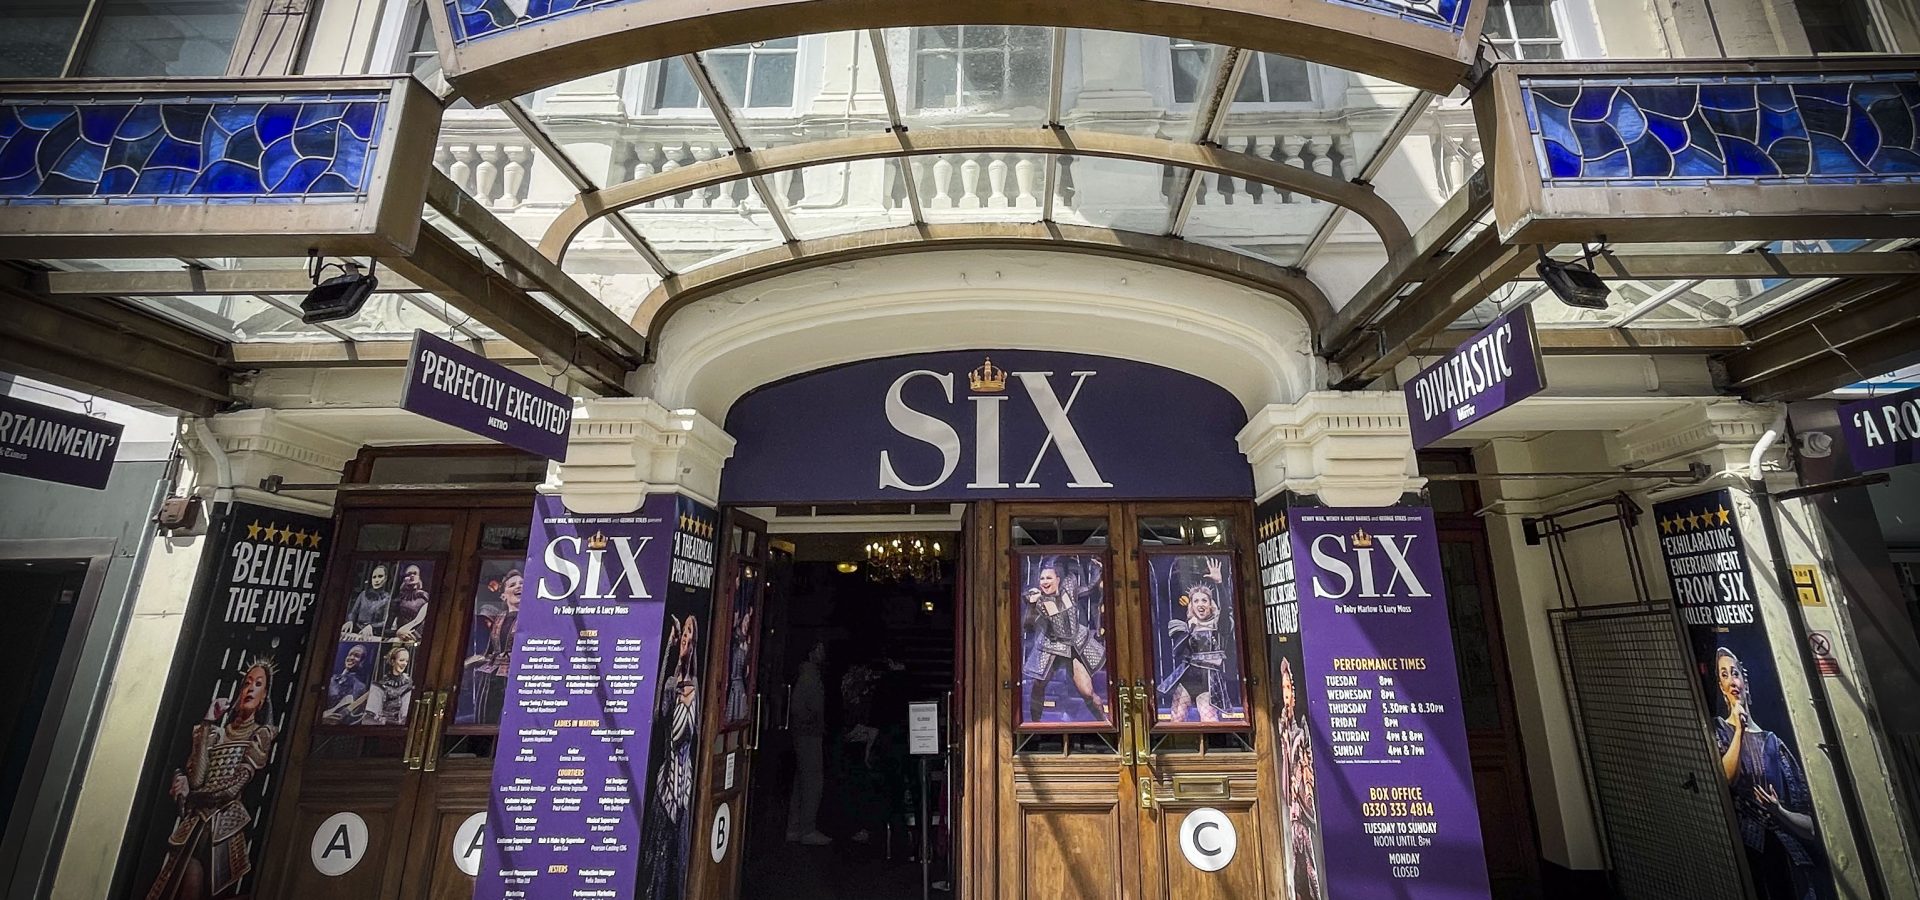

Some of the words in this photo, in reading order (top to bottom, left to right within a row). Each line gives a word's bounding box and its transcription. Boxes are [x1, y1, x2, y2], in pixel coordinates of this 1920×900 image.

[1416, 323, 1512, 421] 'DIVATASTIC'
[421, 350, 505, 411] 'PERFECTLY
[506, 385, 571, 435] EXECUTED'
[488, 416, 508, 431] METRO
[879, 370, 1114, 492] SIX
[1854, 411, 1884, 447] 'A
[1882, 399, 1920, 442] RO
[682, 534, 713, 564] THEATRICAL
[1663, 528, 1736, 556] 'EXHILARATING
[232, 541, 321, 589] 'BELIEVE
[537, 535, 653, 600] SIX
[1311, 533, 1432, 599] SIX
[1670, 551, 1741, 576] ENTERTAINMENT
[1675, 575, 1719, 604] FROM
[1719, 572, 1750, 601] SIX
[224, 587, 263, 623] THE
[261, 590, 315, 625] HYPE'
[553, 606, 561, 616] By
[562, 606, 575, 616] Toby
[576, 606, 596, 616] Marlow
[596, 606, 601, 616] &
[602, 606, 613, 616] Lucy
[614, 606, 629, 616] Moss
[1335, 604, 1343, 614] By
[1343, 604, 1357, 614] Toby
[1357, 604, 1378, 614] Marlow
[1378, 604, 1383, 614] &
[1384, 604, 1397, 614] Lucy
[1397, 604, 1411, 614] Moss
[1714, 604, 1754, 624] QUEENS'
[1333, 658, 1398, 671] PERFORMANCE
[1399, 658, 1426, 670] TIMES
[1325, 676, 1358, 686] TUESDAY
[1379, 676, 1393, 686] 8PM
[1327, 690, 1372, 700] WEDNESDAY
[1380, 690, 1395, 700] 8PM
[1328, 703, 1367, 714] THURSDAY
[1410, 703, 1417, 714] &
[1418, 703, 1444, 714] 8.30PM
[1331, 717, 1357, 728] FRIDAY
[1384, 717, 1398, 728] 8PM
[1332, 731, 1370, 742] SATURDAY
[1386, 731, 1400, 742] 4PM
[1401, 731, 1407, 742] &
[1409, 731, 1424, 742] 8PM
[1333, 745, 1364, 756] SUNDAY
[1388, 745, 1402, 756] 4PM
[1403, 745, 1410, 756] &
[1411, 745, 1425, 756] 7PM
[1369, 788, 1389, 800] BOX
[1391, 788, 1423, 800] OFFICE
[1362, 802, 1387, 816] 0330
[1389, 802, 1408, 816] 333
[1410, 802, 1434, 816] 4814
[716, 816, 725, 850] B
[1363, 822, 1396, 834] TUESDAY
[1396, 822, 1407, 834] TO
[1407, 822, 1437, 834] SUNDAY
[321, 824, 352, 859] A
[1192, 821, 1222, 857] C
[1373, 836, 1395, 847] NOON
[1396, 836, 1417, 847] UNTIL
[1418, 836, 1431, 847] 8PM
[1389, 853, 1420, 865] MONDAY
[1392, 866, 1420, 878] CLOSED
